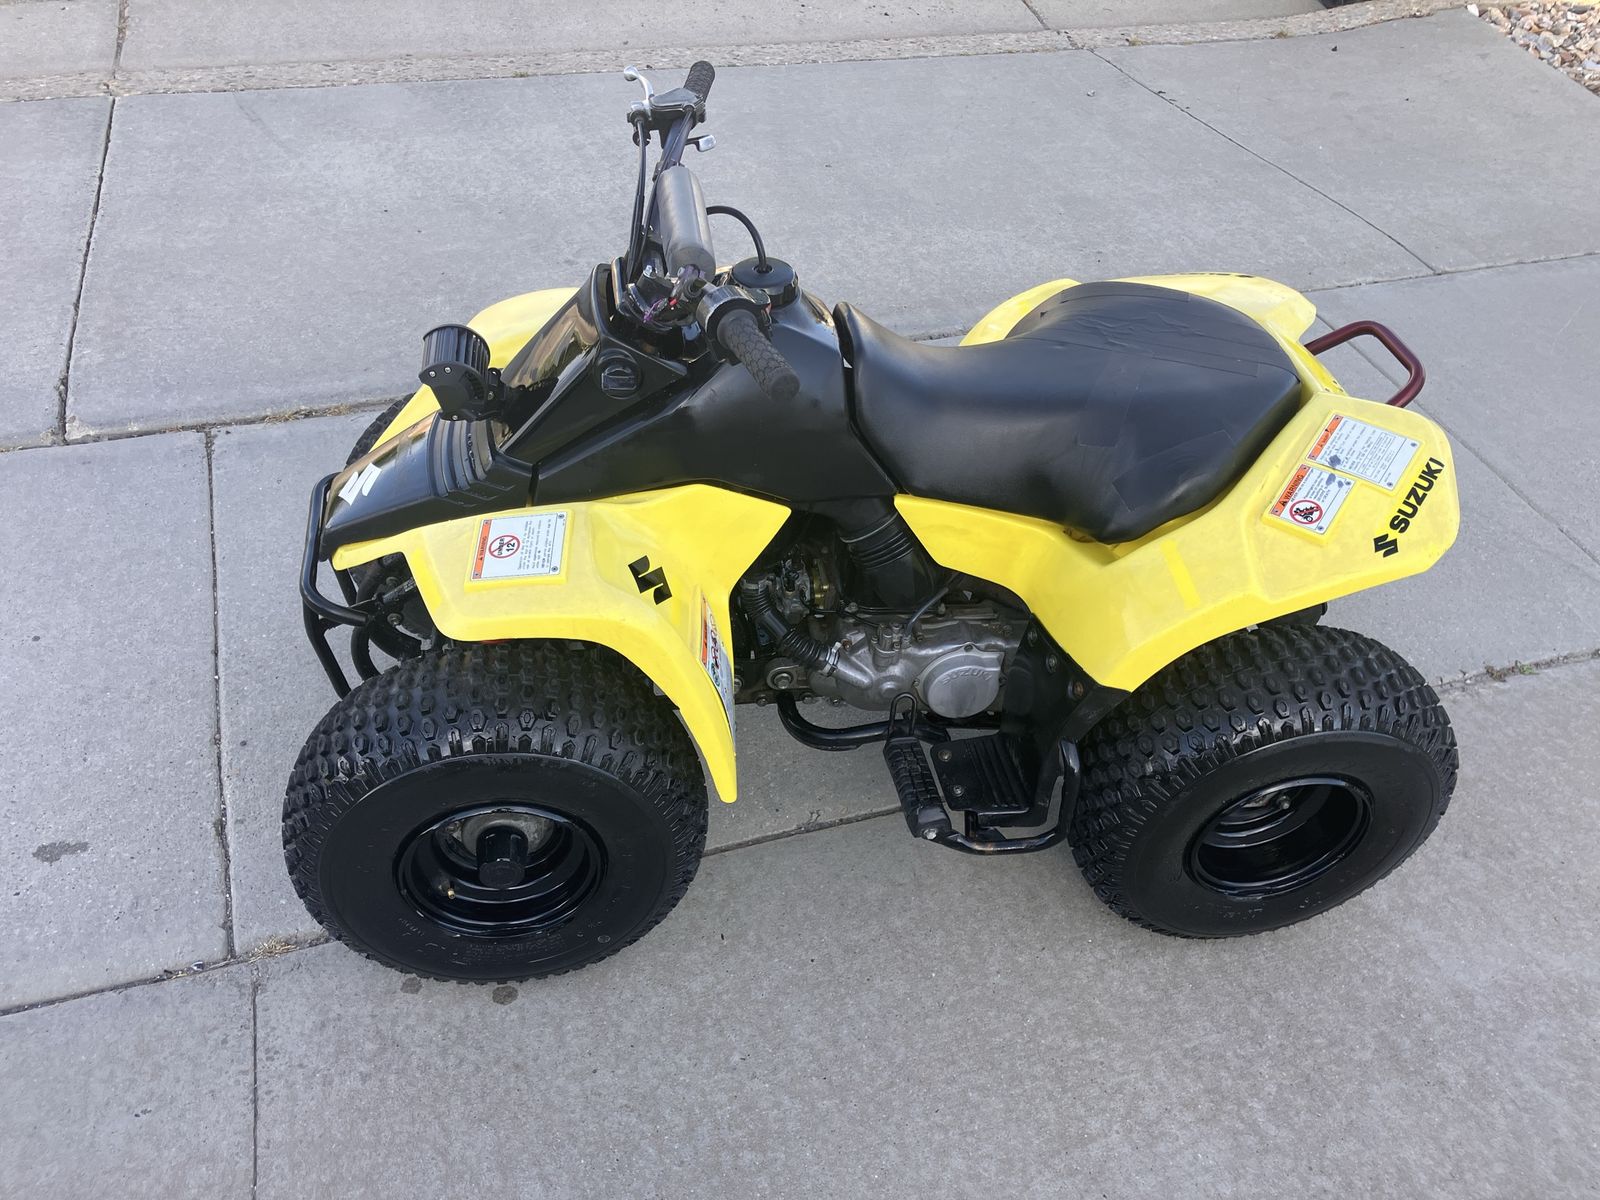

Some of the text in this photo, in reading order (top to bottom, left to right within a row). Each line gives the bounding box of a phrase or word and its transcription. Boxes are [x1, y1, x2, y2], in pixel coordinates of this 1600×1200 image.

[1284, 474, 1304, 503] WARNING
[1389, 457, 1445, 533] SUZUKI
[497, 538, 505, 556] UNDER
[506, 542, 516, 553] 12
[942, 667, 993, 686] SUZUKI
